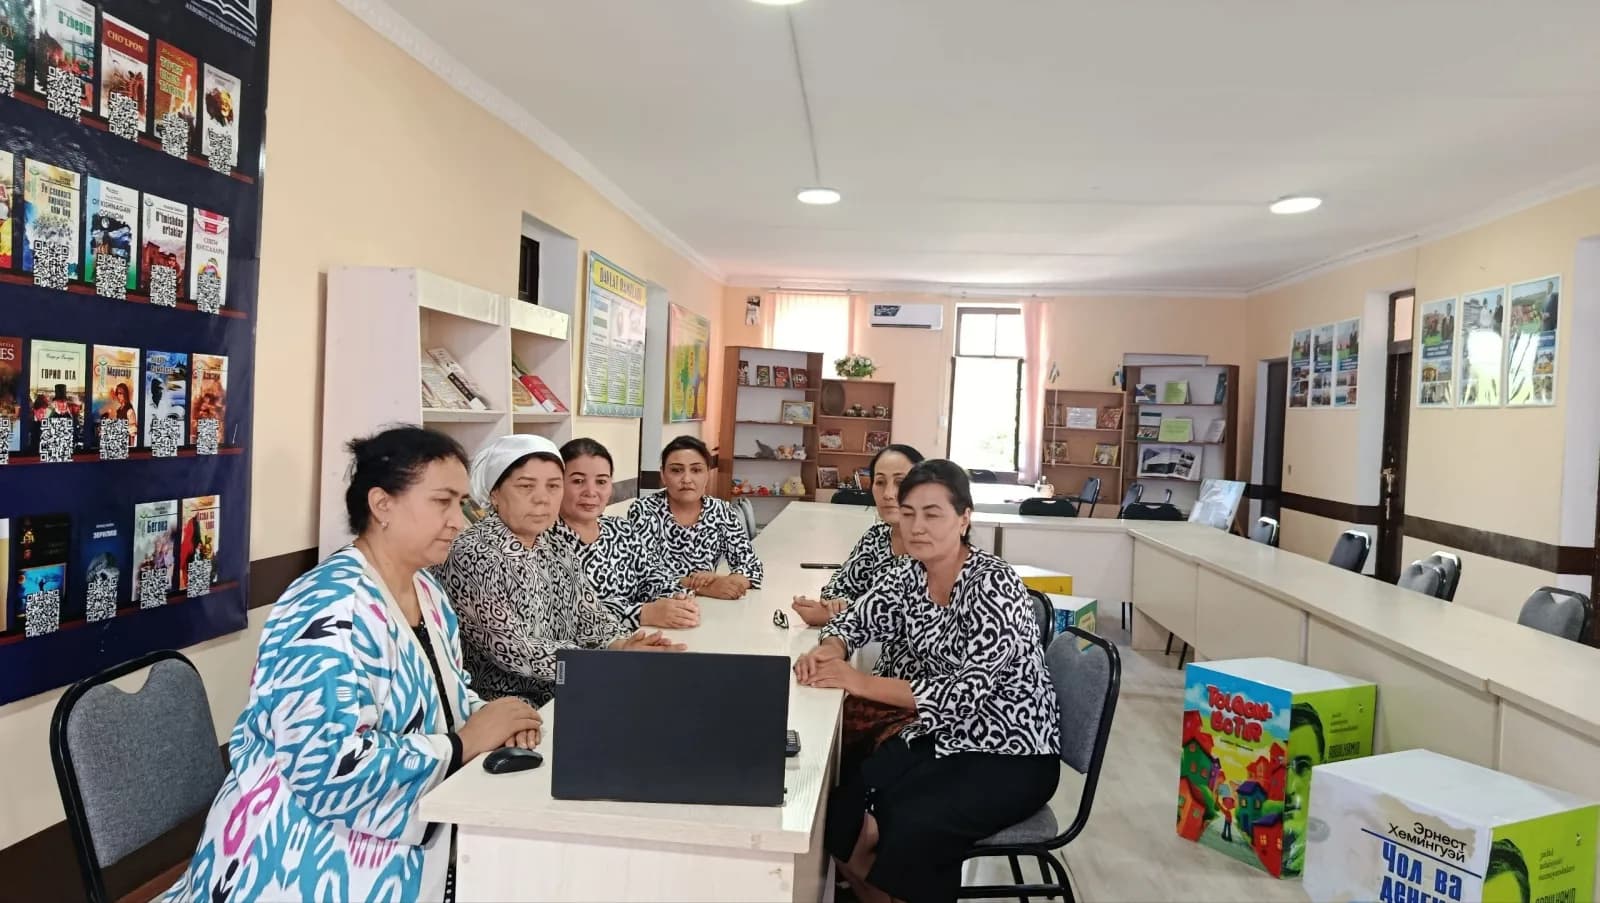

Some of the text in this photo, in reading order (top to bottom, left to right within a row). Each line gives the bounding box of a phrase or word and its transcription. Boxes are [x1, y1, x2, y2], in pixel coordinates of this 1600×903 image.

[41, 368, 76, 380] ГОРИО ОТА
[1388, 823, 1465, 863] Хемингуэй
[1413, 822, 1467, 851] Эрнест
